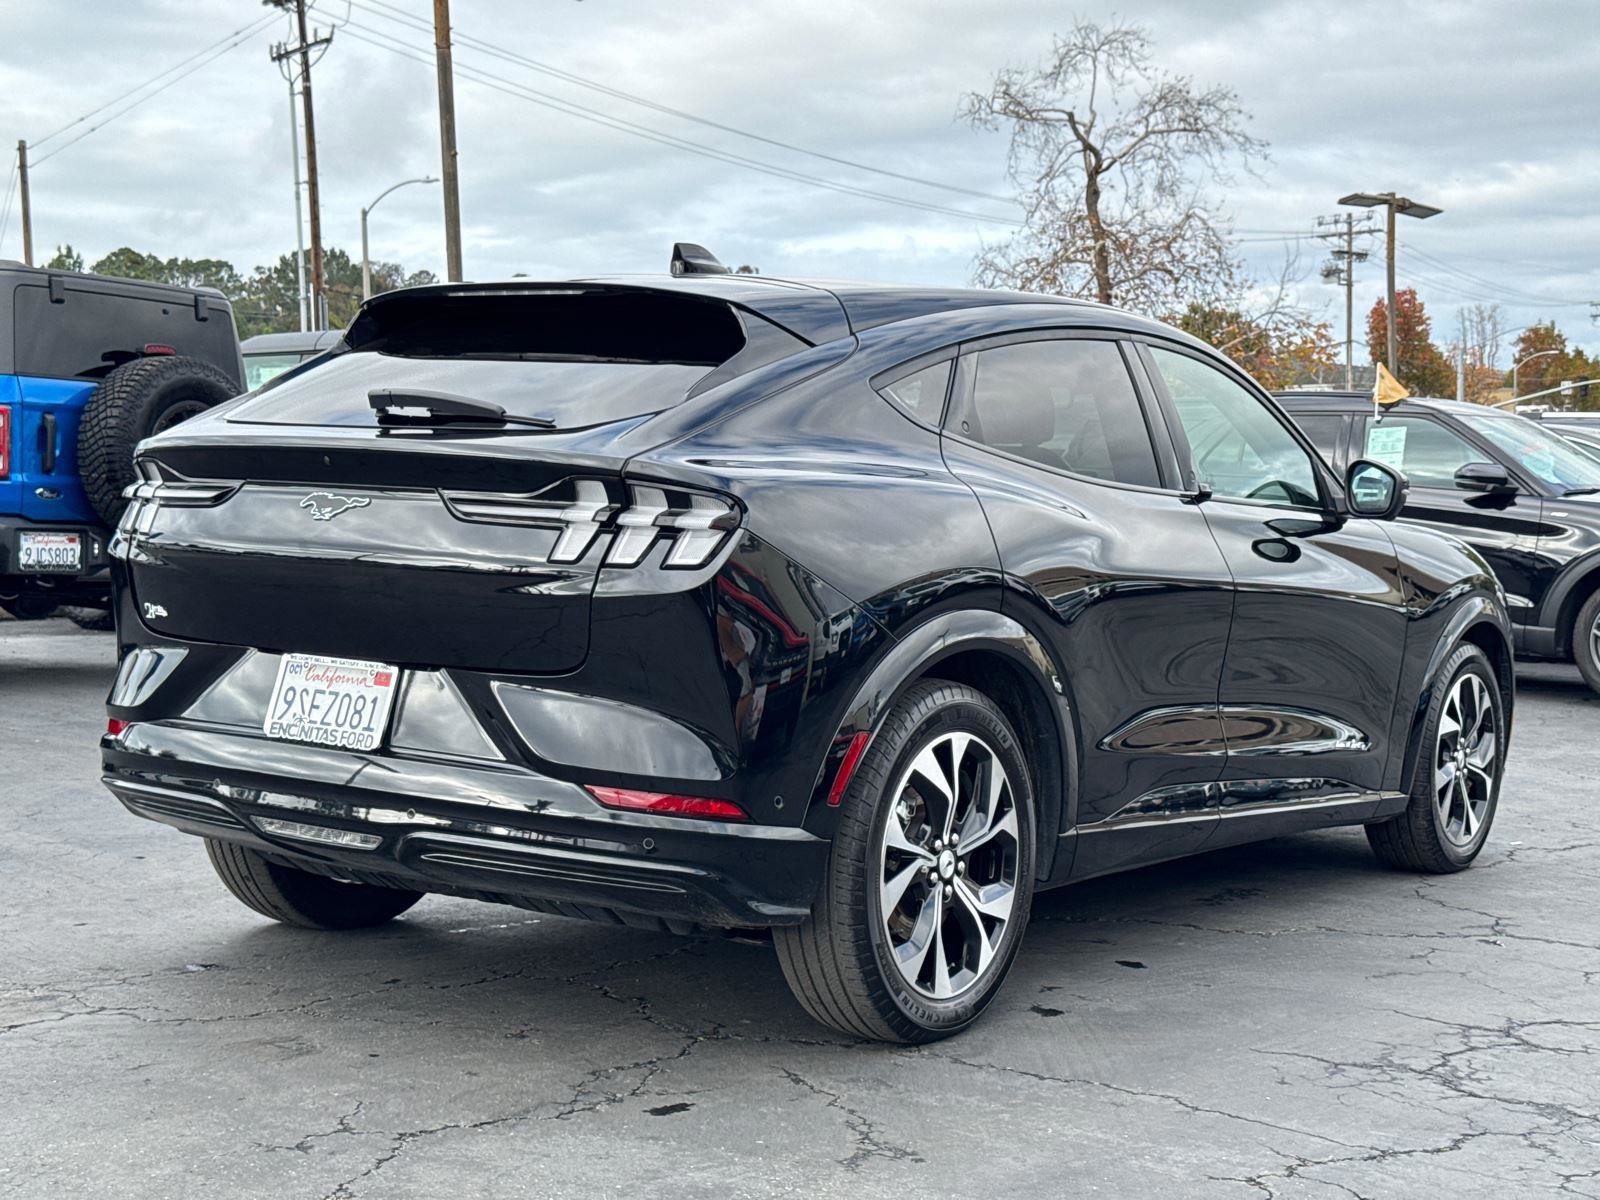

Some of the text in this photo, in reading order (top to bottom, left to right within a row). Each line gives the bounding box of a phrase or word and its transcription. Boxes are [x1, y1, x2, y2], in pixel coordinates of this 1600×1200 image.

[25, 547, 76, 564] 9JCS803
[289, 663, 303, 675] OCT
[304, 662, 374, 689] California
[277, 686, 379, 733] 9SEZ081
[269, 722, 374, 749] ENCINITAS FORD
